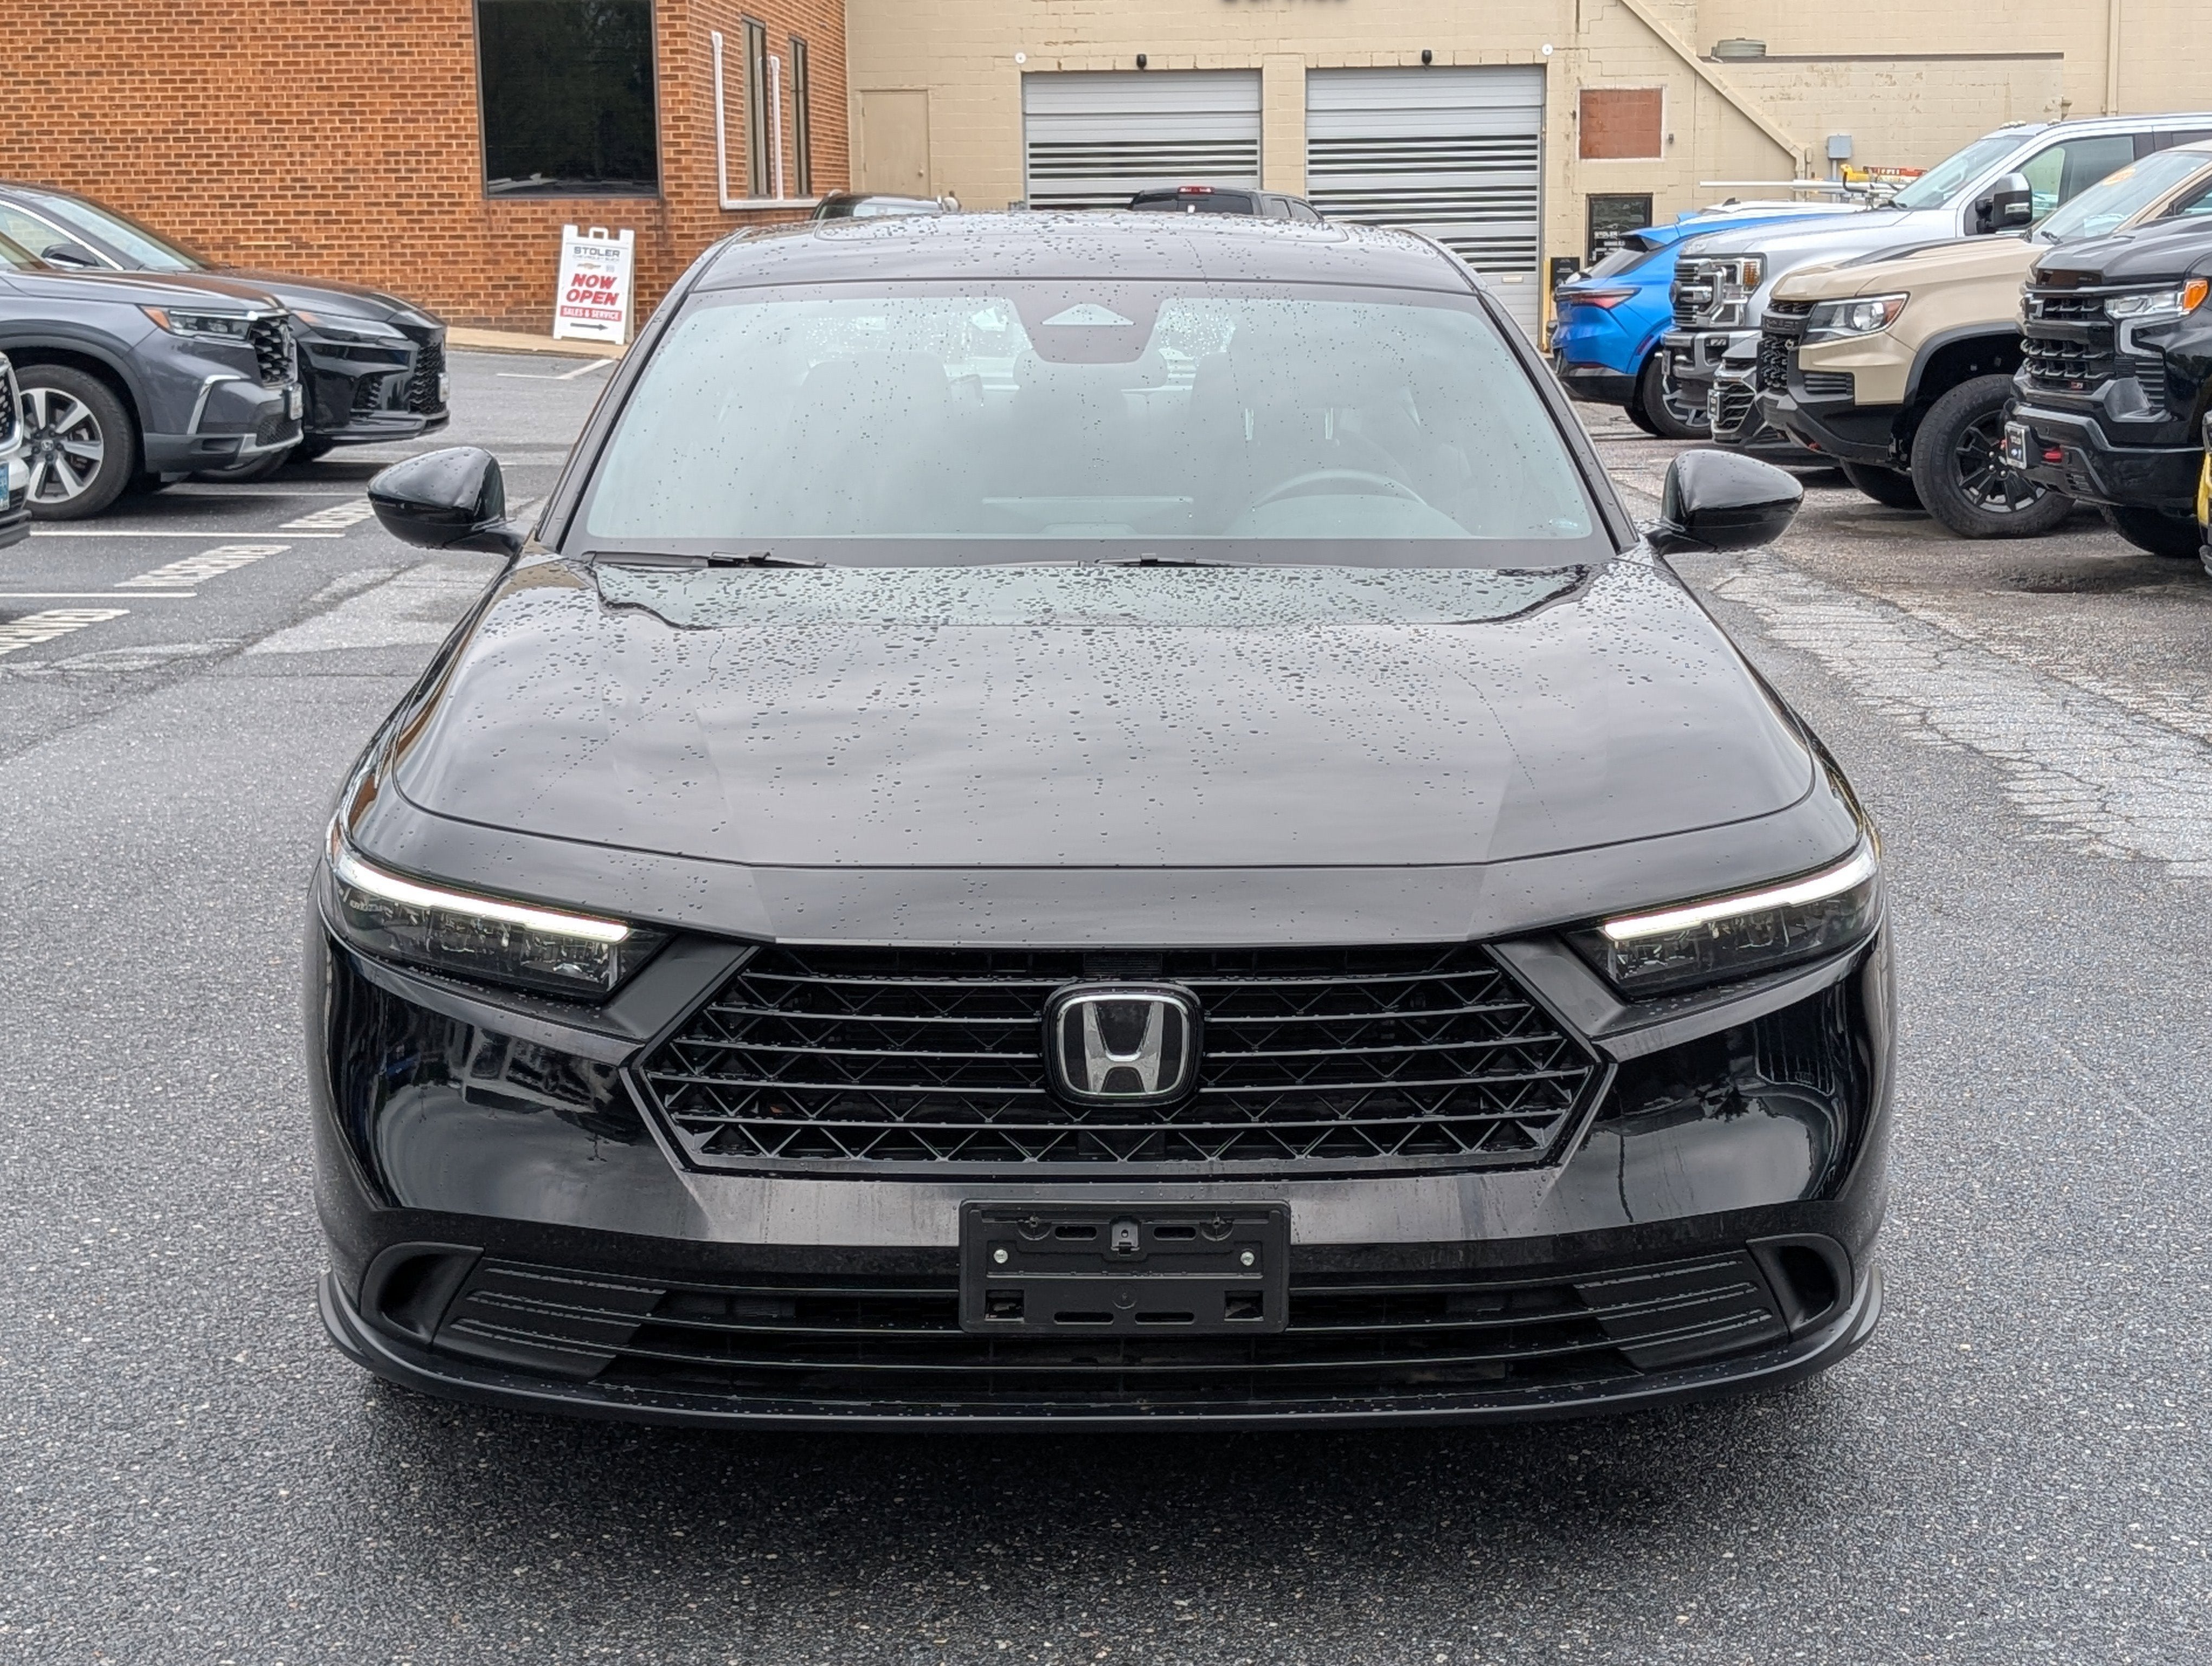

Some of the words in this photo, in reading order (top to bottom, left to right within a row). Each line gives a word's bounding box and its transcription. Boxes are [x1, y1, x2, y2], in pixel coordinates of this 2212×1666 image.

[574, 246, 620, 257] STOLER
[571, 273, 617, 289] NOW
[566, 289, 620, 306] OPEN
[563, 307, 583, 317] SALES
[591, 310, 619, 321] SERVICE
